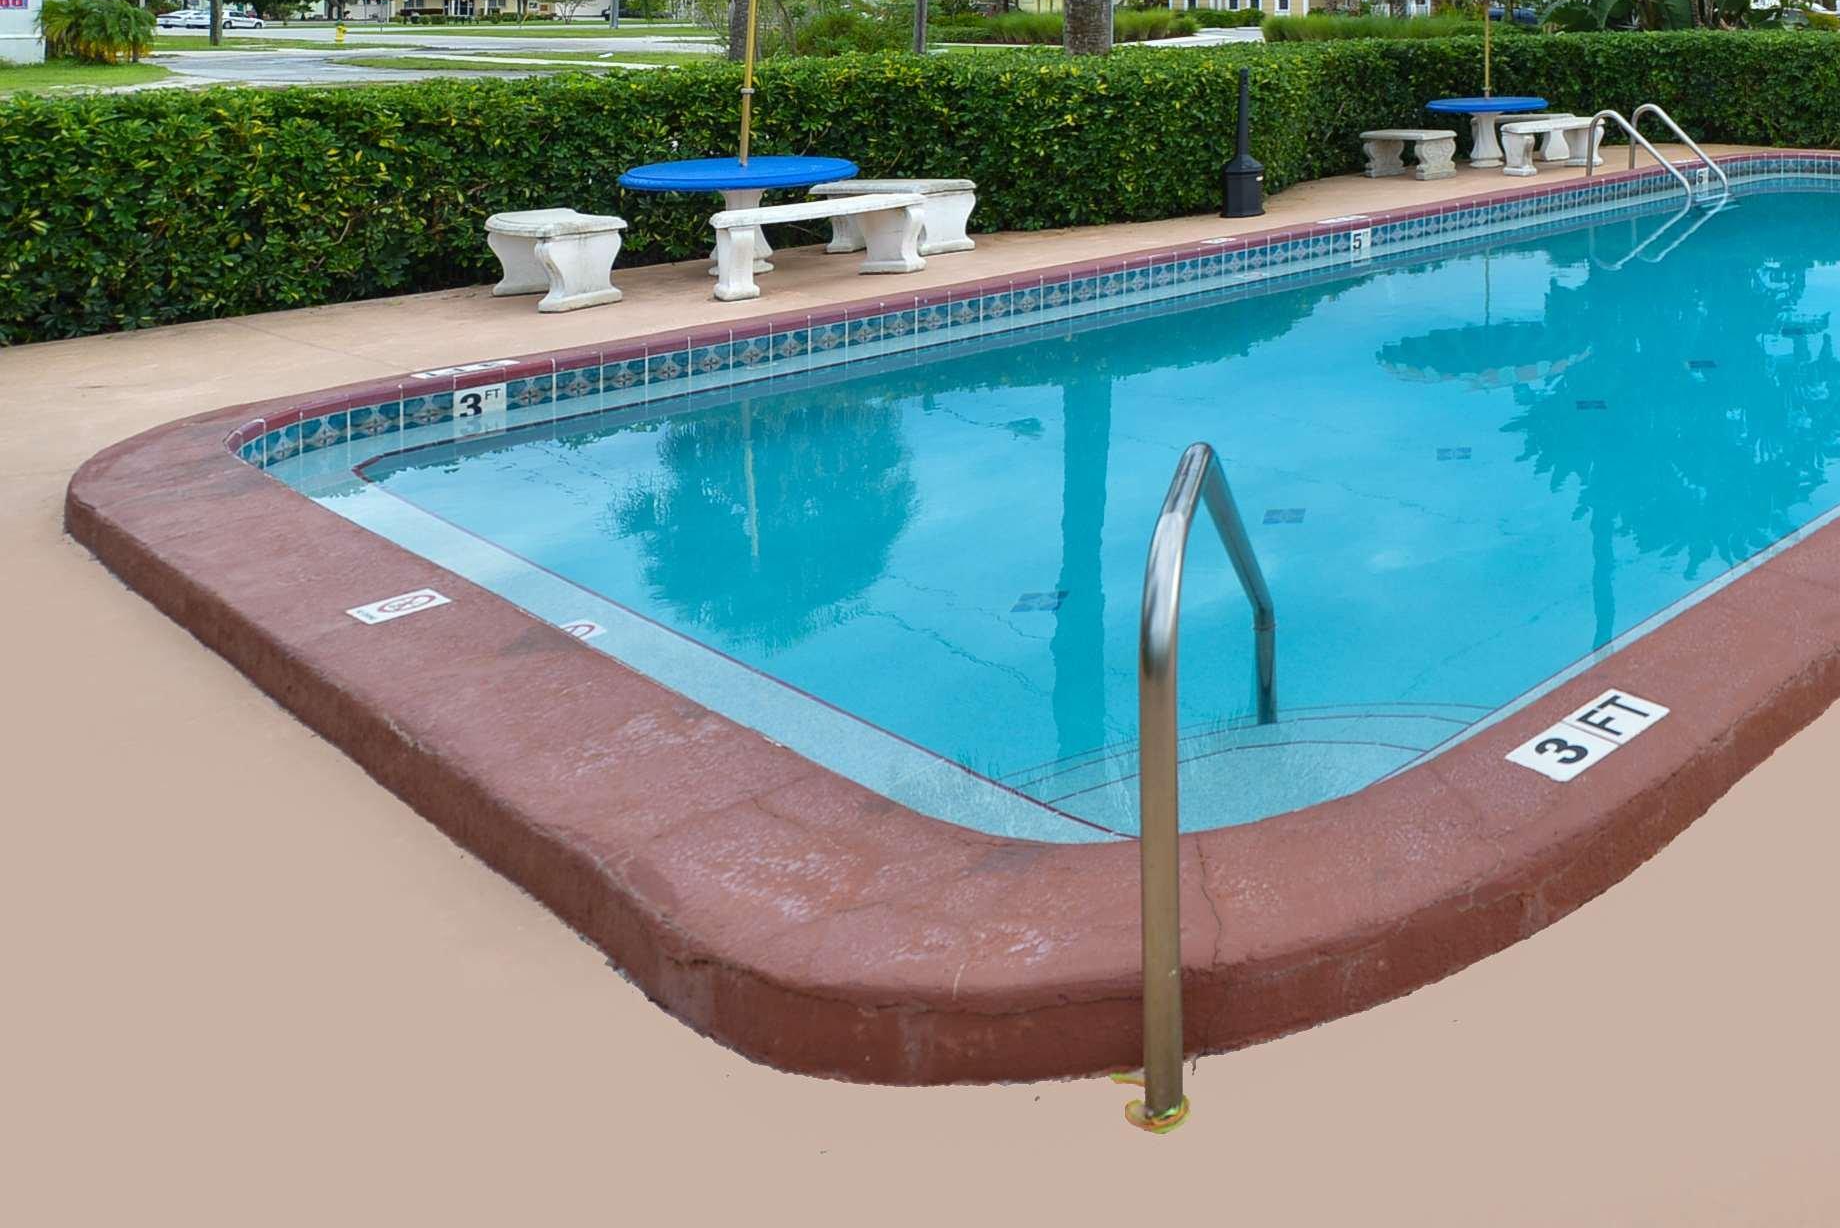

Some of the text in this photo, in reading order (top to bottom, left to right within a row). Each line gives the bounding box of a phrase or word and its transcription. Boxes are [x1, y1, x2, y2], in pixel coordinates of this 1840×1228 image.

[1353, 233, 1362, 249] 5
[459, 388, 501, 417] 3 FT
[1535, 695, 1649, 764] 3 FT
